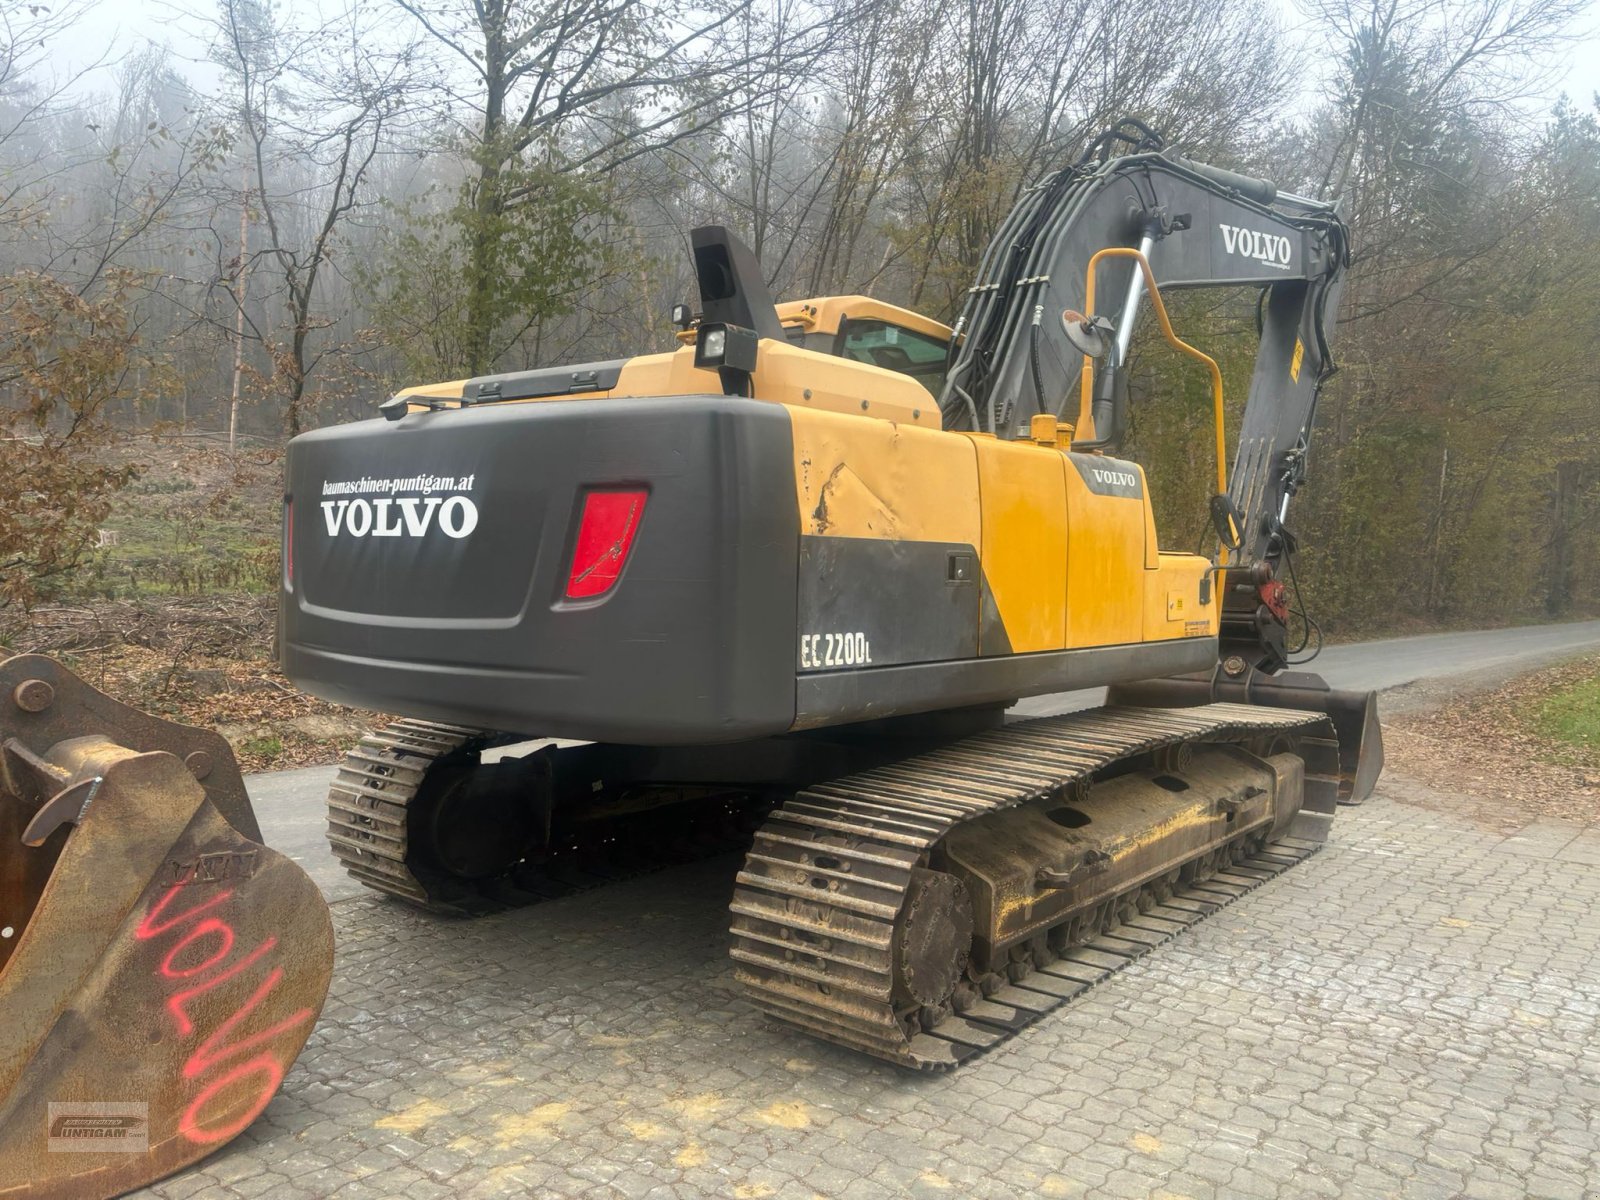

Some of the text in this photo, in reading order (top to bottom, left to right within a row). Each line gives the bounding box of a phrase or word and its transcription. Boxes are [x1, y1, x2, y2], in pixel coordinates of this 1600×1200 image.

[1219, 223, 1292, 264] VOLVO
[322, 473, 475, 495] baumaschinen-puntigam.at
[1092, 469, 1136, 487] VOLVO
[320, 495, 479, 539] VOLVO
[135, 868, 314, 1144] VOLVO
